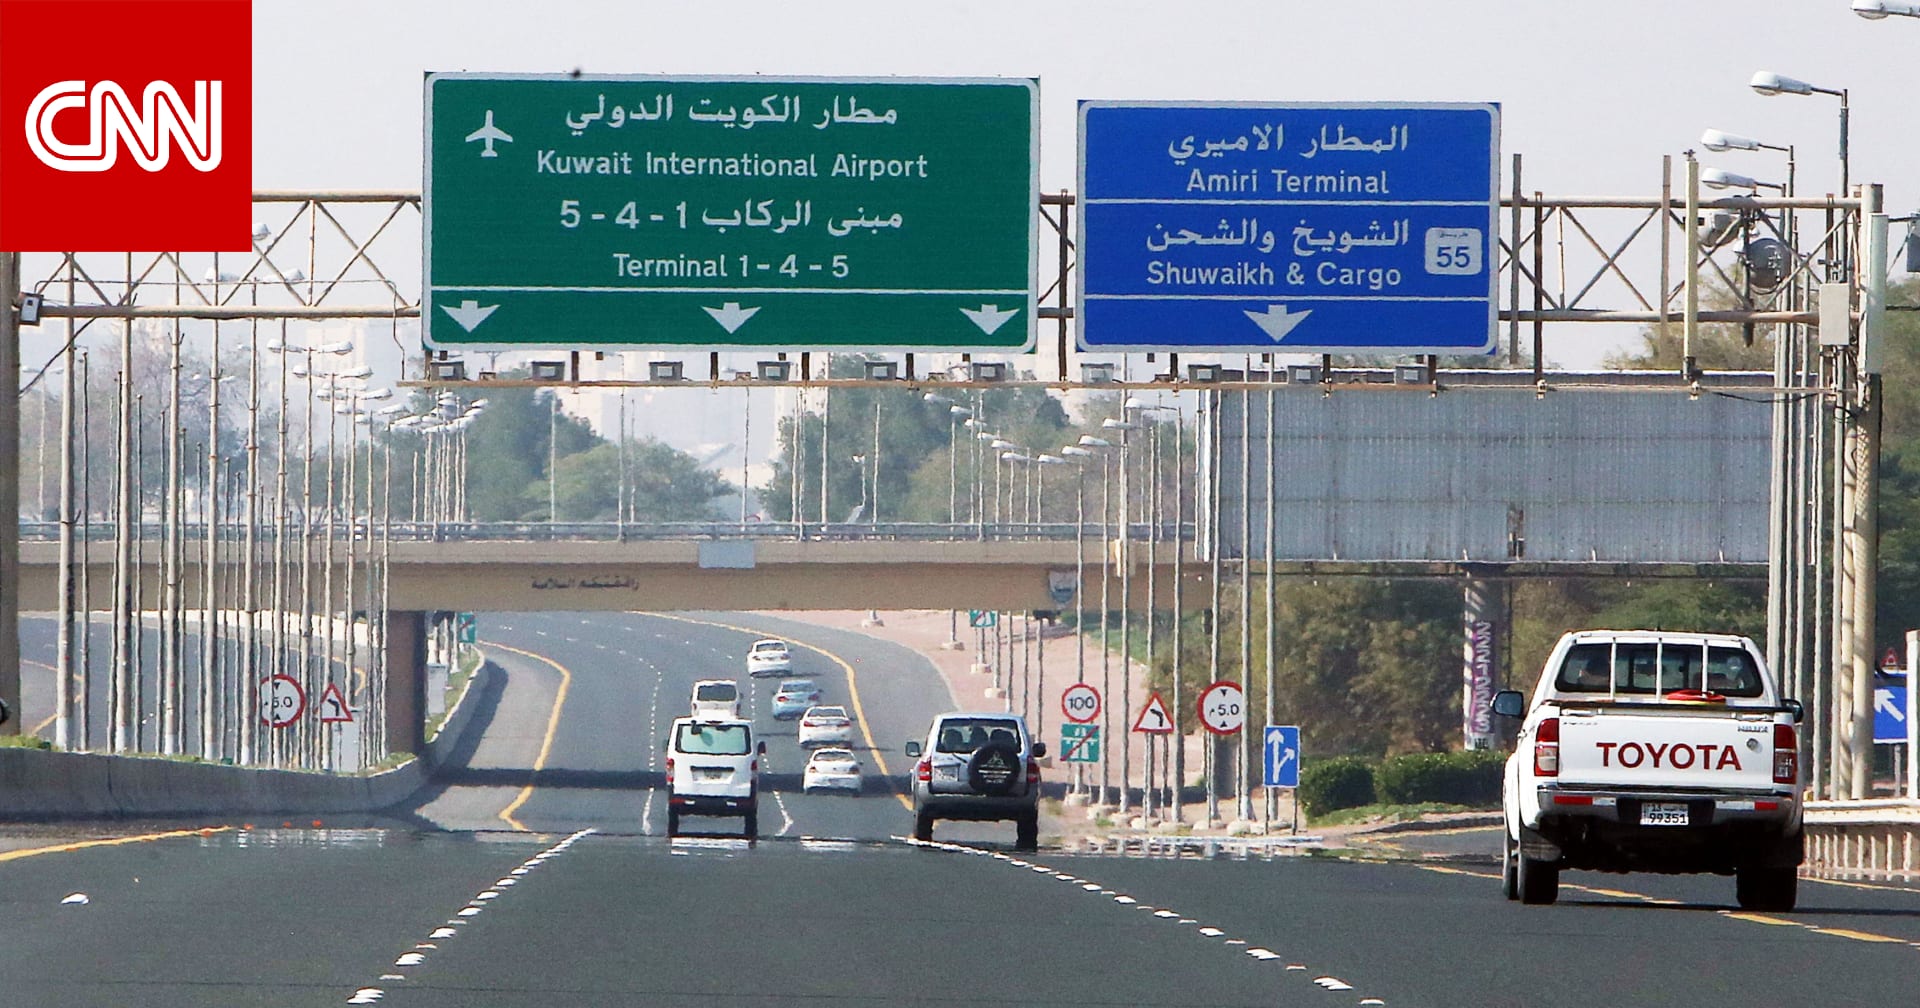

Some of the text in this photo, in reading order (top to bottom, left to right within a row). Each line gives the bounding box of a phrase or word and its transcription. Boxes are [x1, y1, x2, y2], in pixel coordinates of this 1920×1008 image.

[566, 93, 898, 136] مطار الكويت الدولي
[1168, 123, 1408, 165] المطار الاميري
[537, 150, 928, 182] Kuwait International Airport
[1187, 168, 1389, 195] Amiri Terminal
[561, 199, 581, 228] 5
[615, 201, 640, 229] 4
[677, 201, 687, 229] 1
[702, 199, 811, 234] الركاب
[827, 206, 903, 236] مبنى
[1146, 217, 1410, 256] الشويخ والشحن
[613, 253, 728, 277] Terminal
[779, 254, 799, 278] 4
[832, 255, 849, 278] 5
[1436, 246, 1471, 268] 55
[1146, 260, 1402, 291] Shuwaikh & Cargo
[1067, 696, 1095, 711] 100
[1218, 703, 1240, 716] 5.0
[1596, 742, 1742, 770] TOYOTA
[1649, 813, 1687, 824] 99351
